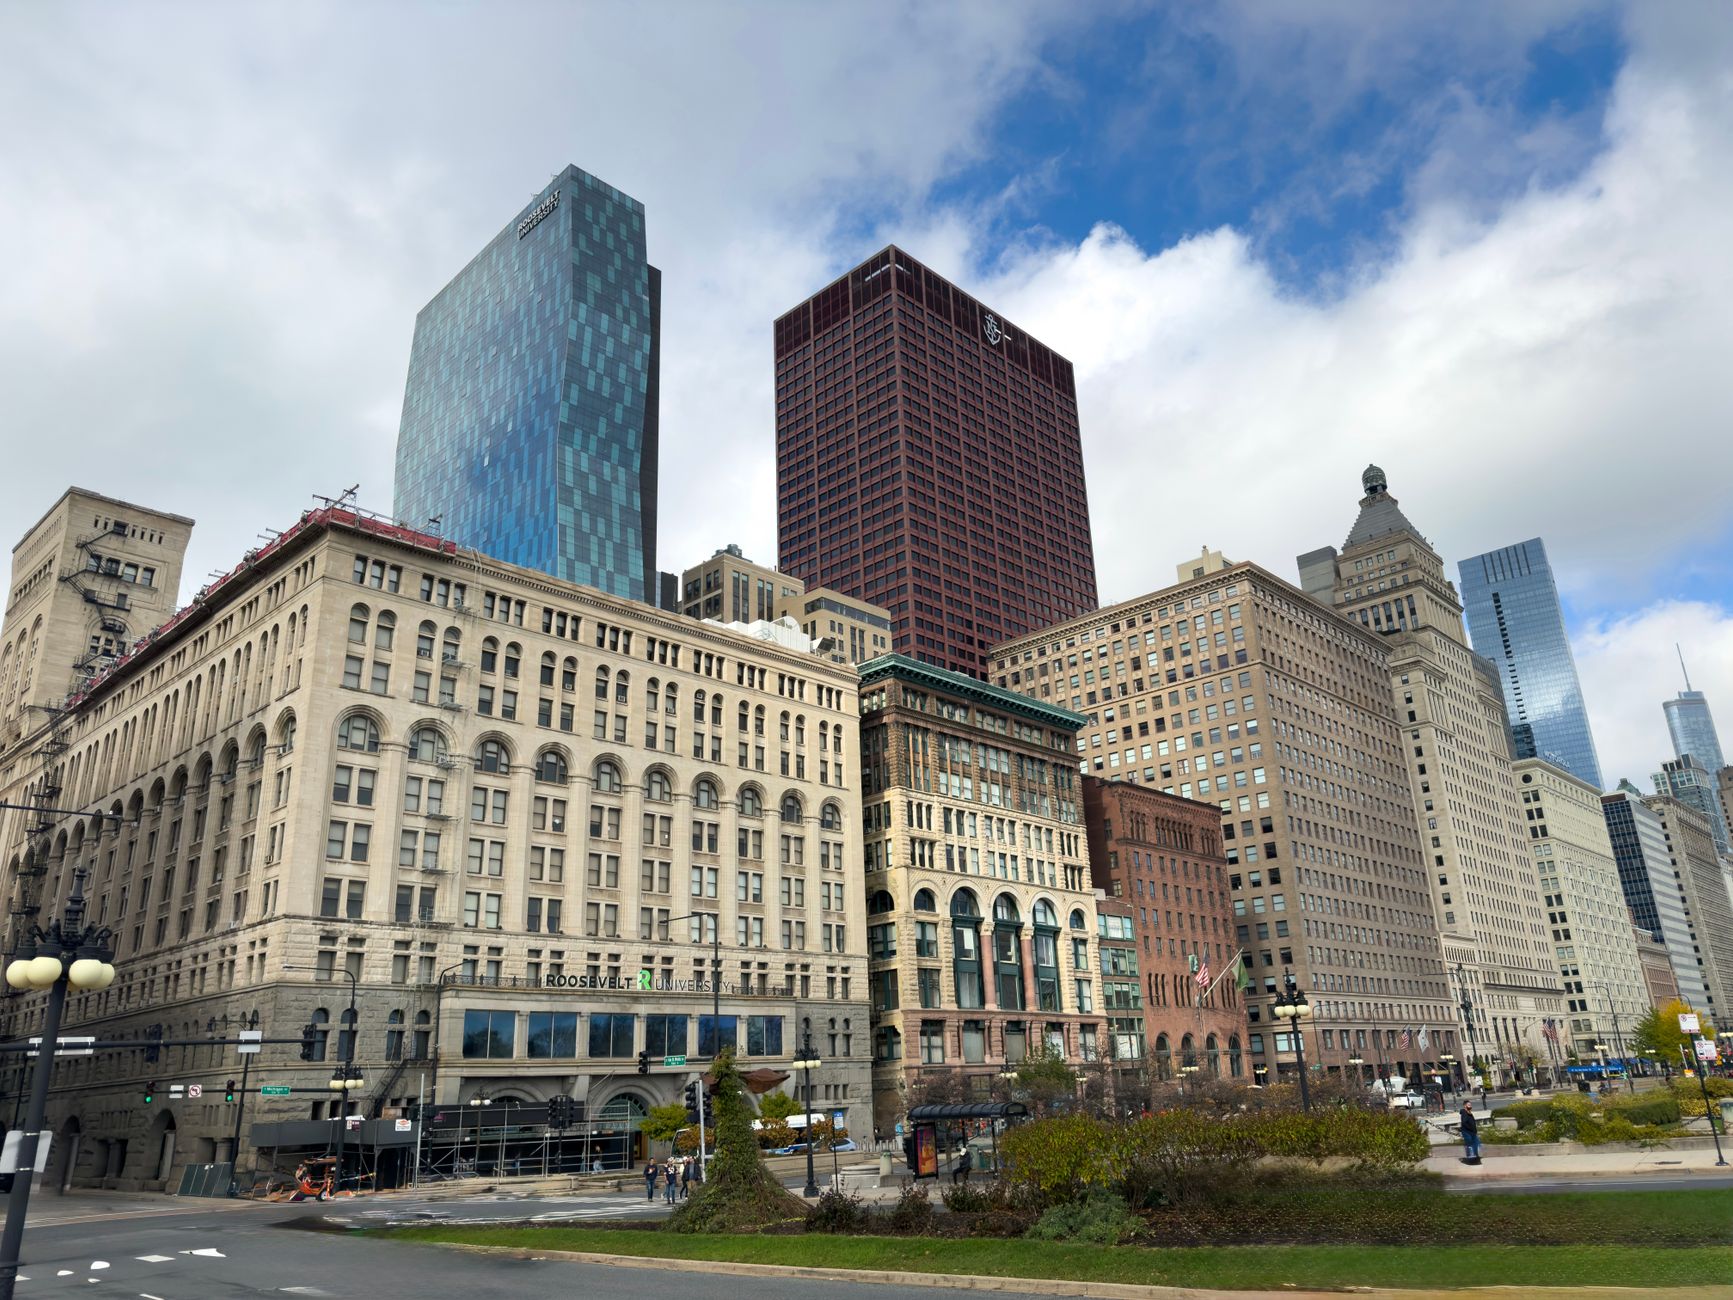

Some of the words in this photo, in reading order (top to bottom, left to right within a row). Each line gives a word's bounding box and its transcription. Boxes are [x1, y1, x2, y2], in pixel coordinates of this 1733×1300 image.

[518, 190, 560, 230] ROOSEVELT
[518, 199, 559, 239] UNIVERSITY
[545, 974, 633, 989] ROOSEVELT
[655, 978, 730, 992] UNIVERSIY
